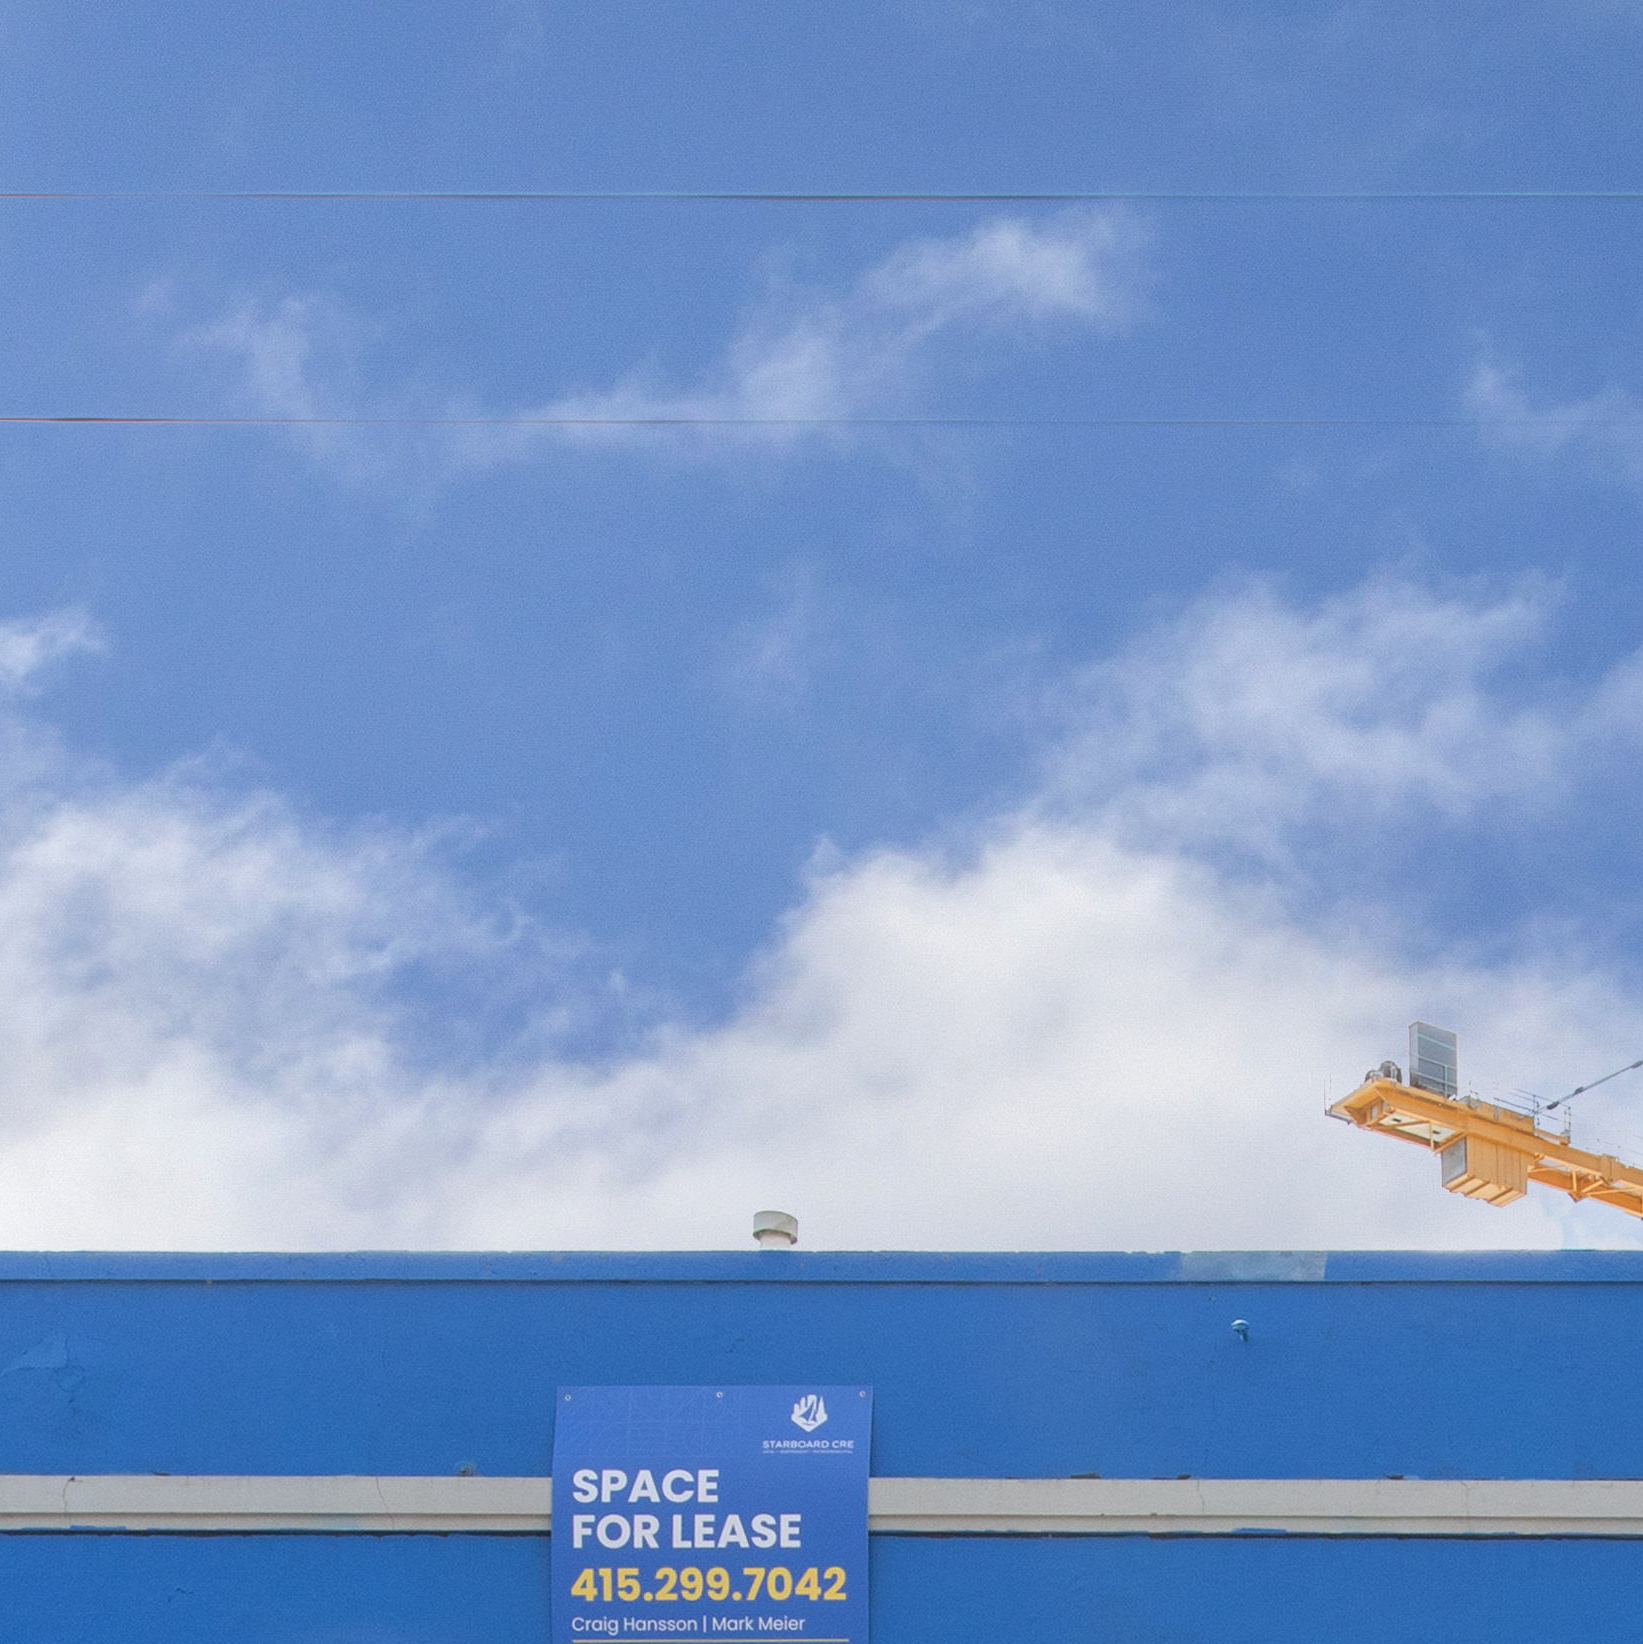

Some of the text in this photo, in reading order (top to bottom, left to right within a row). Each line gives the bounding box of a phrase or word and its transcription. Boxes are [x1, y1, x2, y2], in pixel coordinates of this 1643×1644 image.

[762, 1440, 854, 1450] STARBOARD CRE
[572, 1469, 719, 1503] SPACE
[572, 1514, 802, 1549] FOR LEASE
[571, 1567, 847, 1602] 415.299.7042
[572, 1617, 619, 1636] Craig
[624, 1616, 698, 1632] Hansson
[712, 1616, 755, 1632] Mark
[758, 1615, 806, 1631] Meier
